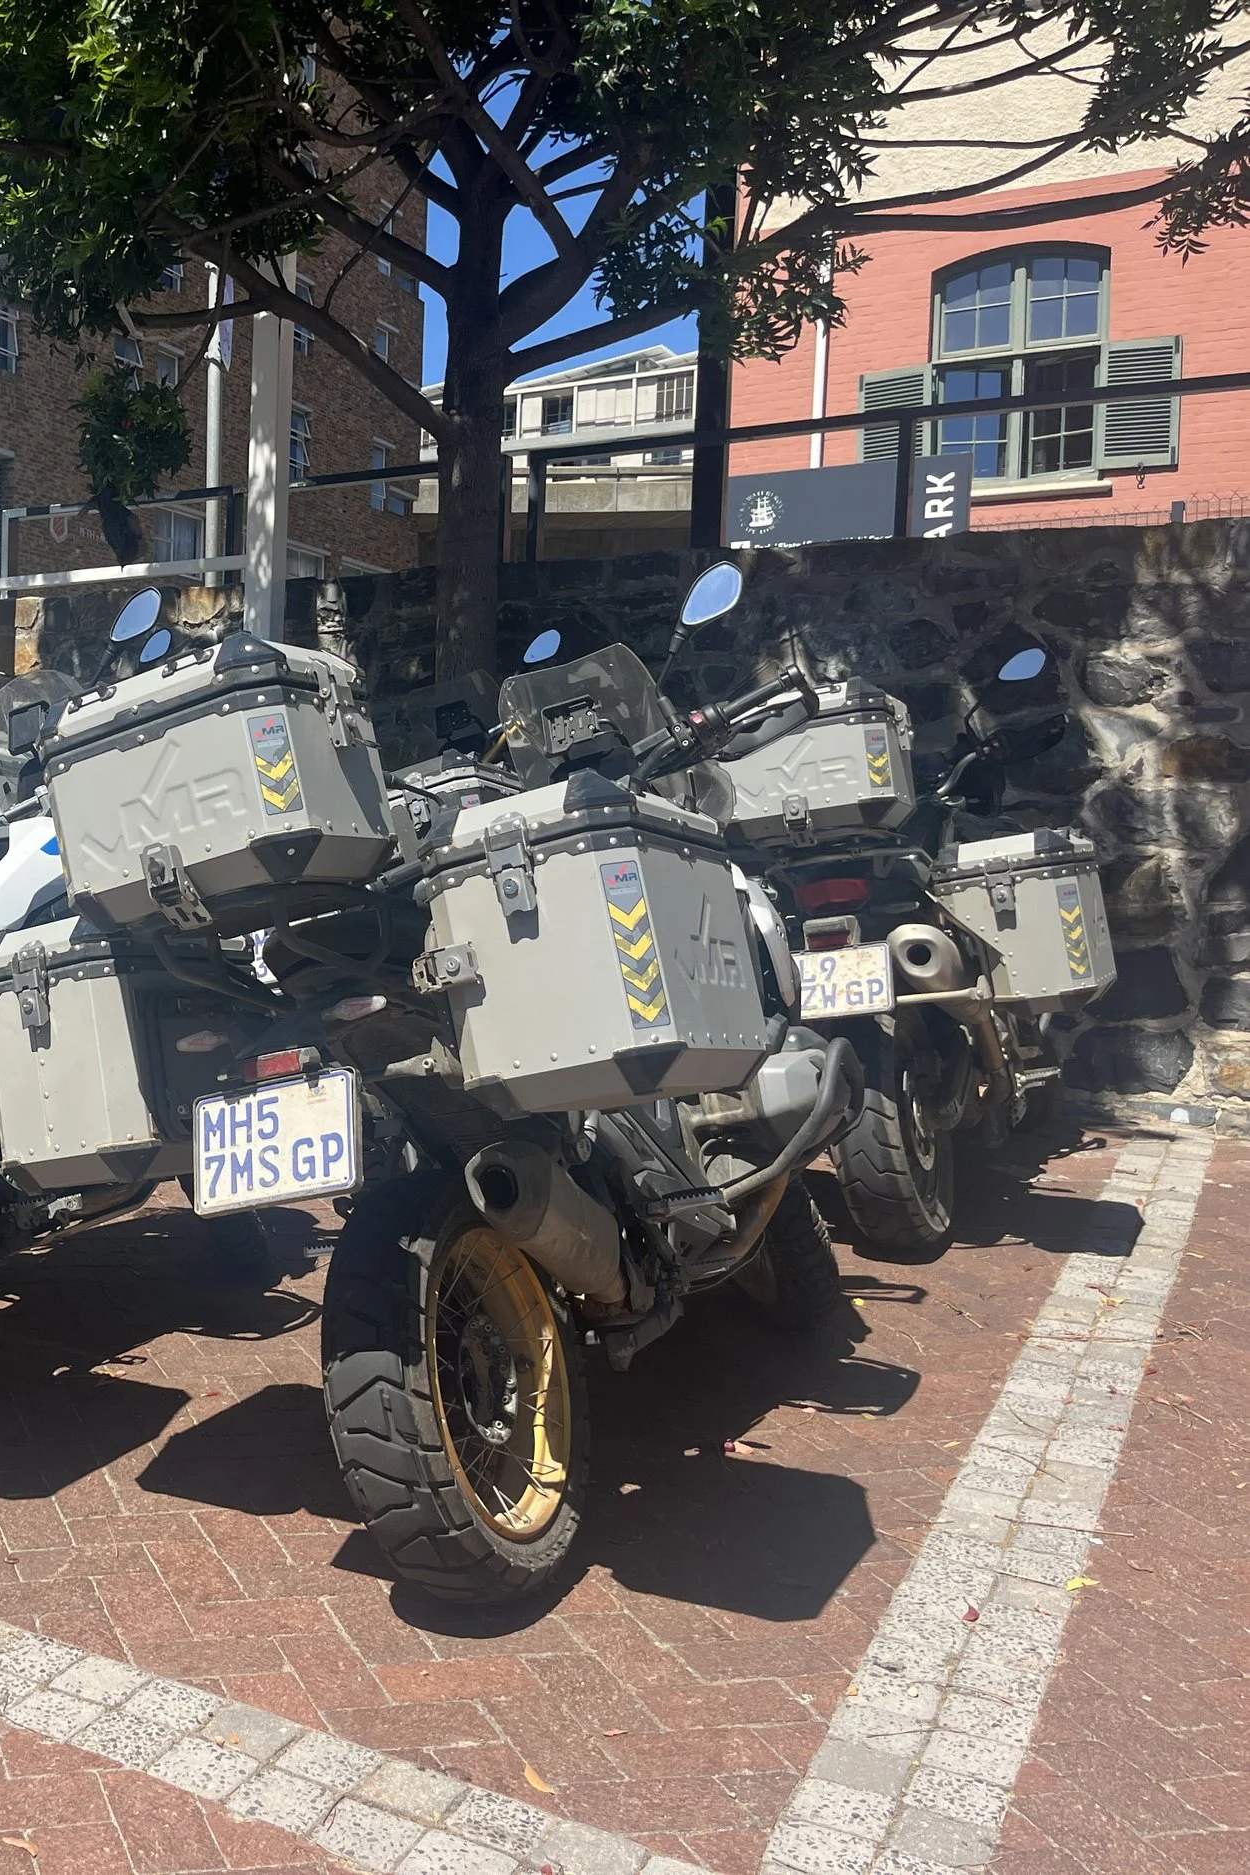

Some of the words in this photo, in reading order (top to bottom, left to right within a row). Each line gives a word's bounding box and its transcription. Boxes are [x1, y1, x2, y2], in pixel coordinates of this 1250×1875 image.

[923, 471, 956, 538] ARK
[799, 956, 837, 983] L9
[801, 983, 838, 1010] ZW
[846, 978, 884, 1005] GP
[203, 1096, 280, 1152] MH5
[205, 1145, 280, 1198] 7MS
[292, 1132, 344, 1182] GP
